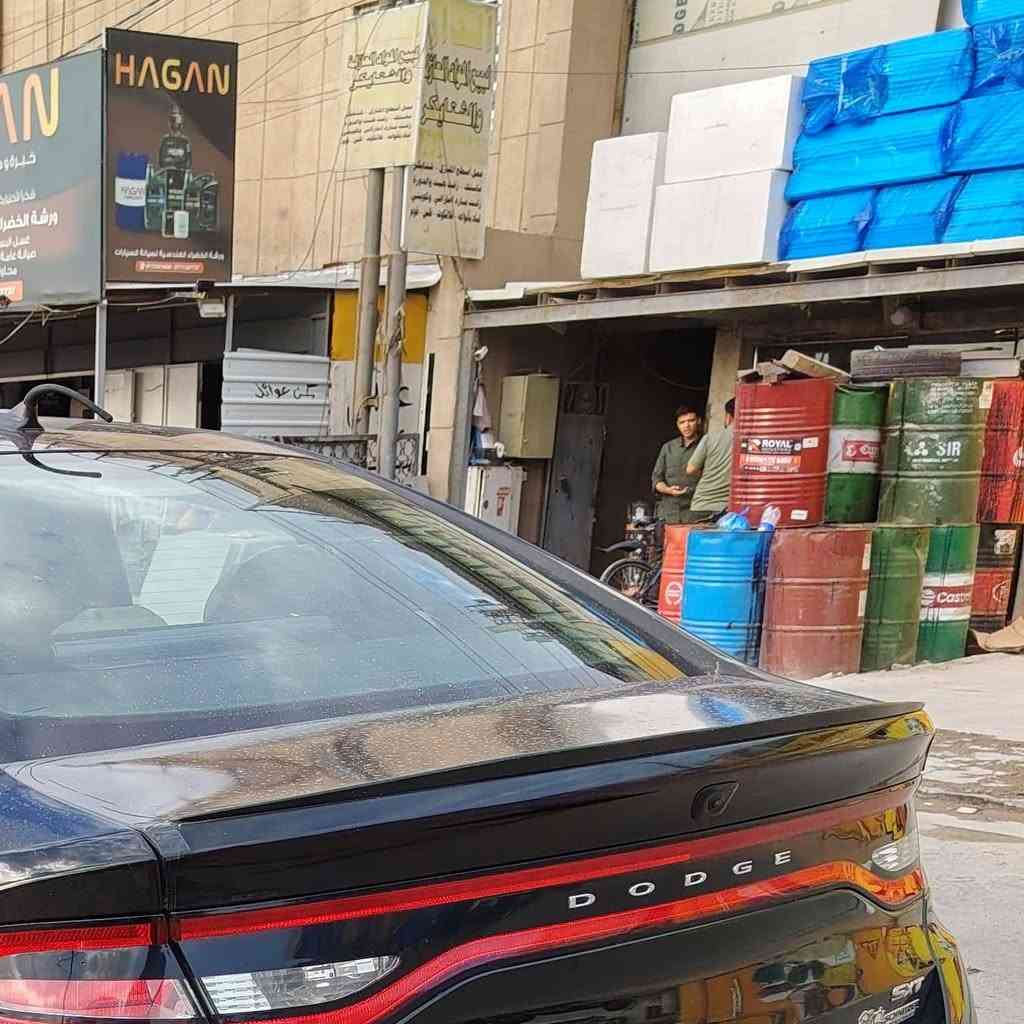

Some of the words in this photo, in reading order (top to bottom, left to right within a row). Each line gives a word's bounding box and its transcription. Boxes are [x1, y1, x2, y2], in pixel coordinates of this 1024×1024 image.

[115, 52, 230, 95] HAGAN
[31, 208, 58, 227] ورشة
[761, 439, 792, 449] ROYAL
[568, 850, 792, 909] DODGE
